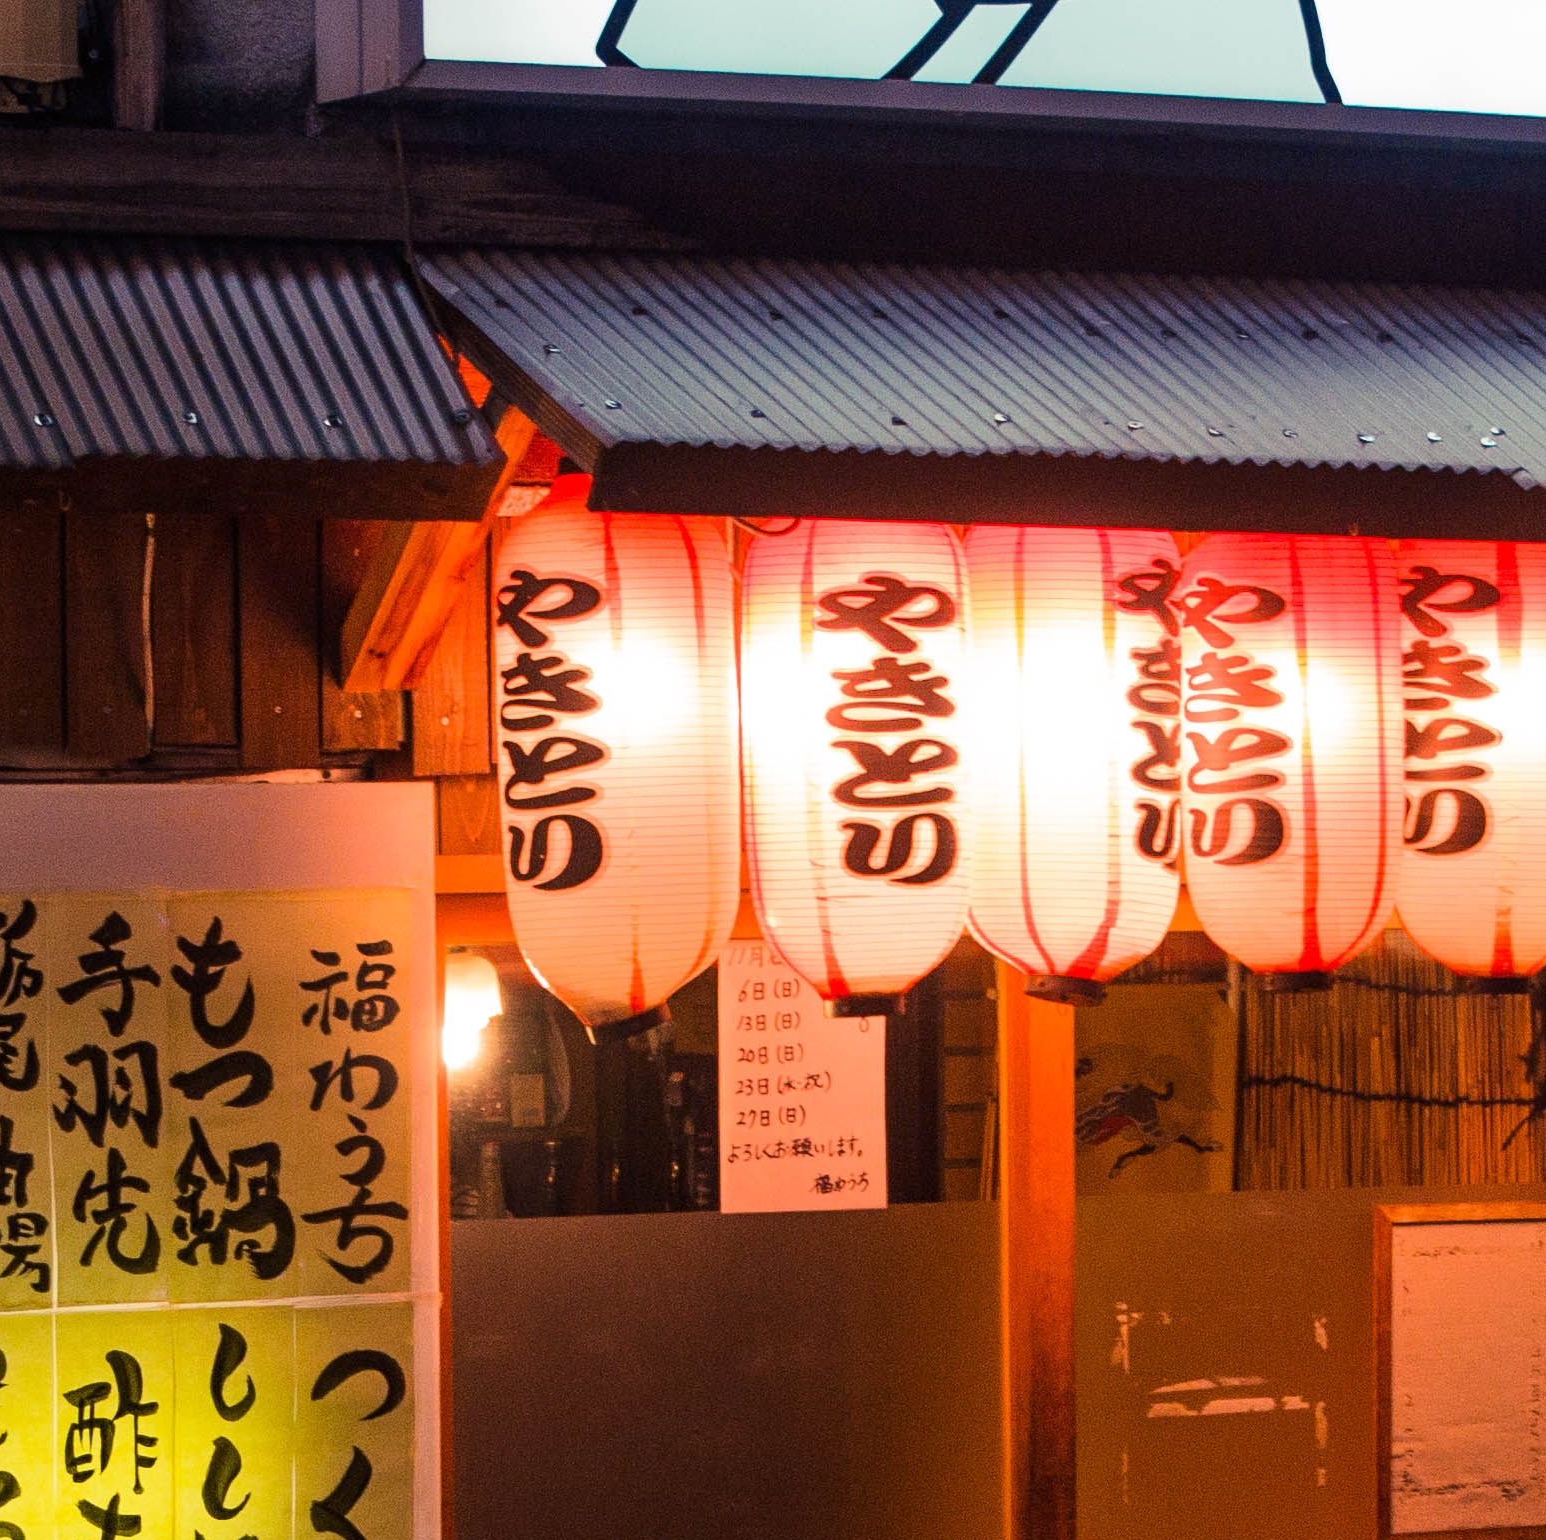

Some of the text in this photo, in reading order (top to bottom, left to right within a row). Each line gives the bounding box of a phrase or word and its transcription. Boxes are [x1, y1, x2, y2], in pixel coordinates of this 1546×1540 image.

[496, 569, 605, 891] やきとり
[815, 572, 957, 885] やきとり
[1180, 577, 1291, 865] やきとり
[54, 911, 162, 1276] 手羽先
[169, 917, 295, 1280] もつ鍋
[299, 939, 408, 1283] 福わうち
